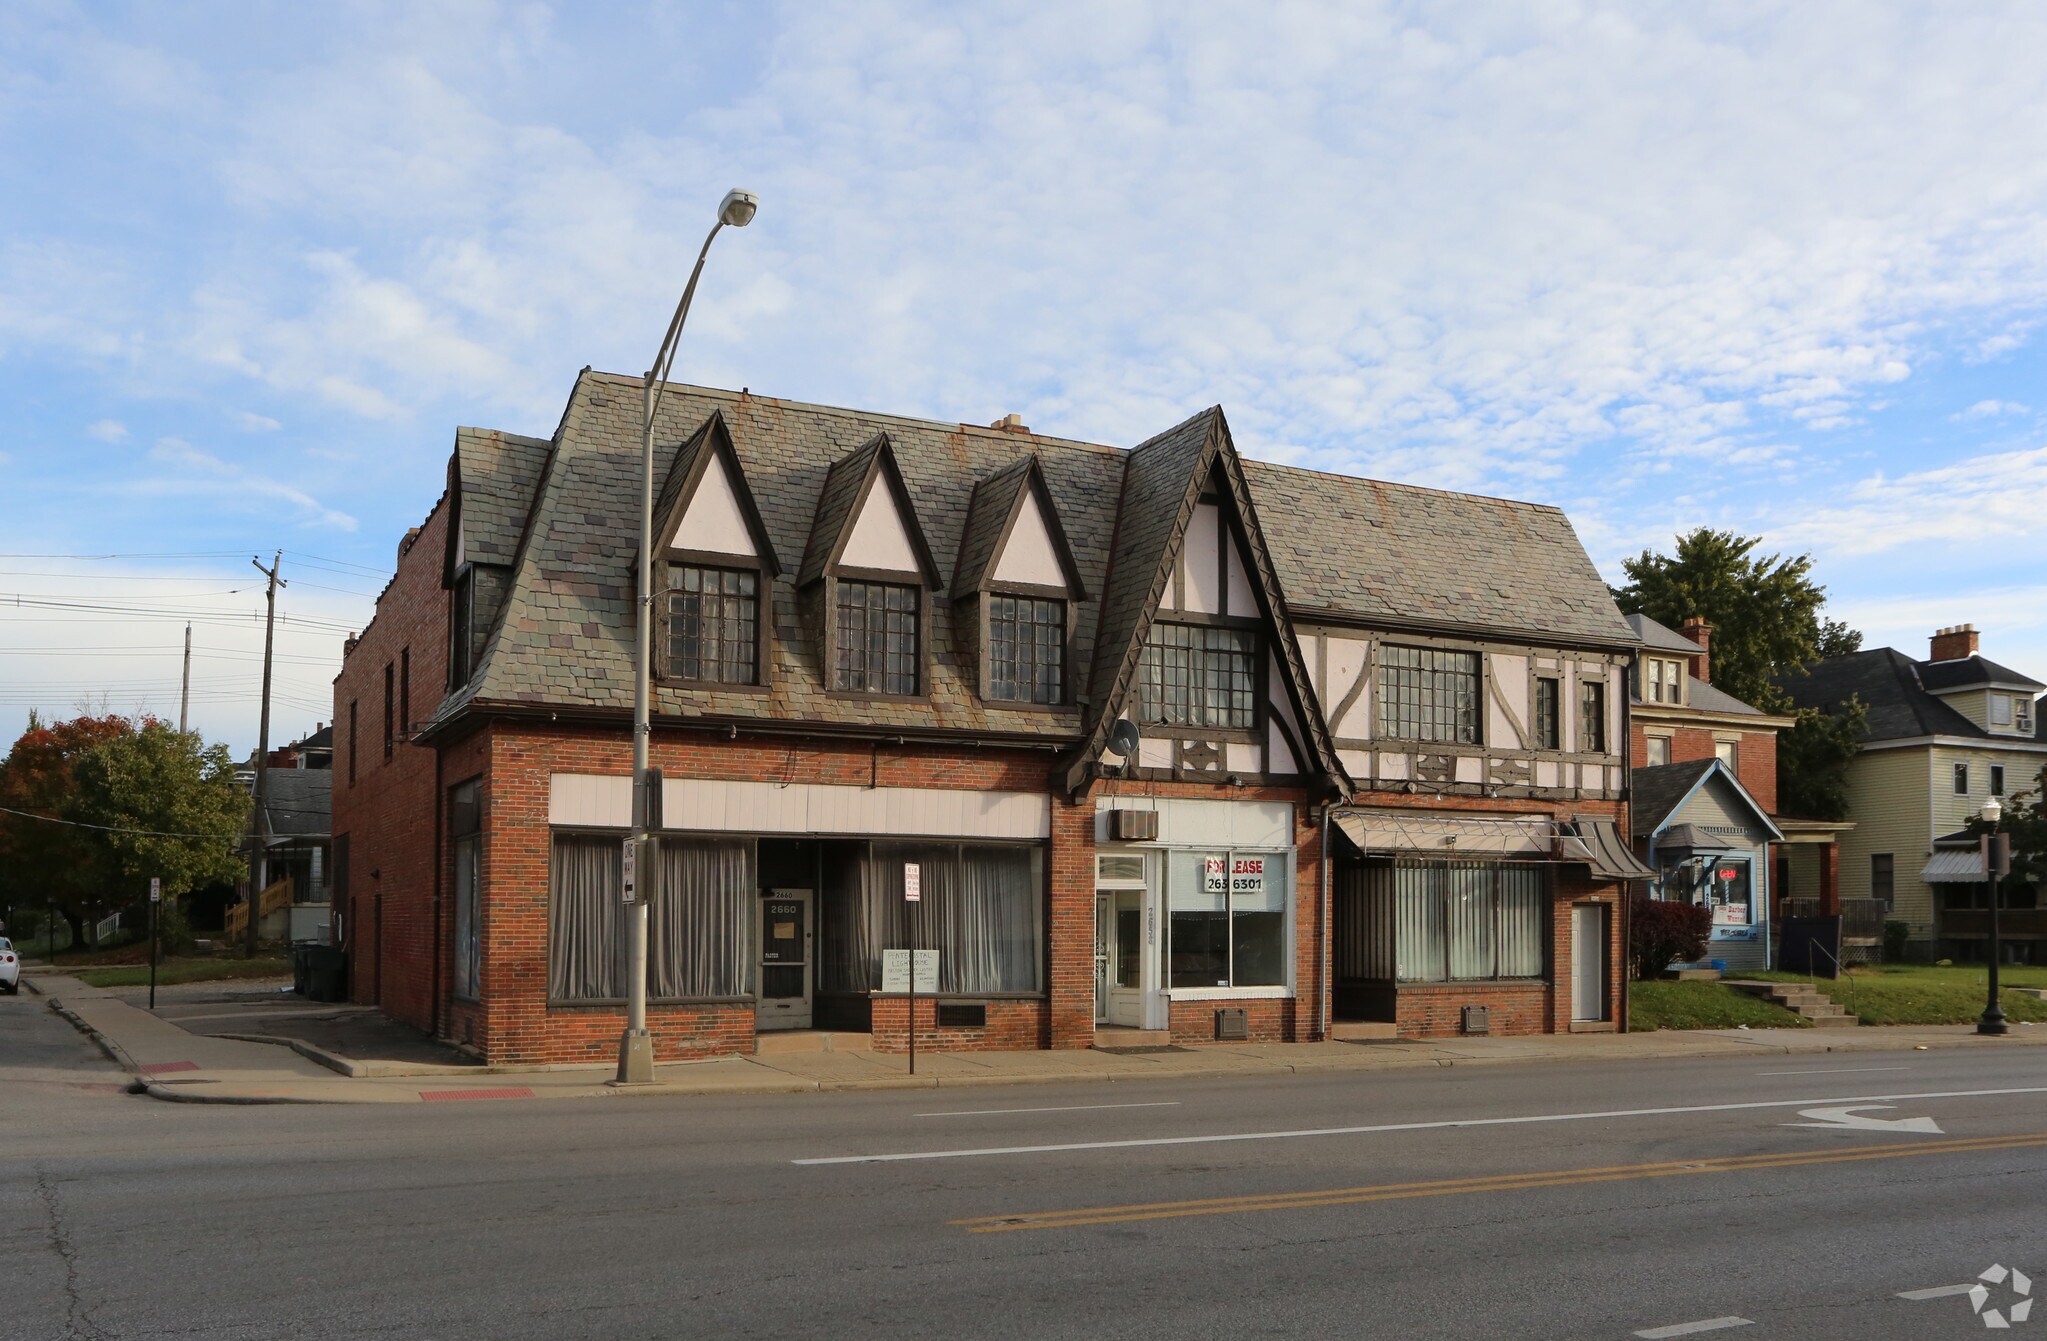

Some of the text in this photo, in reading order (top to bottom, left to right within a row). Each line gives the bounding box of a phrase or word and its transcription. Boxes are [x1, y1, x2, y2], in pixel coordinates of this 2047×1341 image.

[625, 843, 633, 858] ONE
[624, 861, 633, 875] WAY
[1207, 860, 1225, 873] FOR
[1208, 878, 1261, 889] 263 6301
[771, 905, 796, 914] 2660
[888, 952, 932, 960] PENTESTAL
